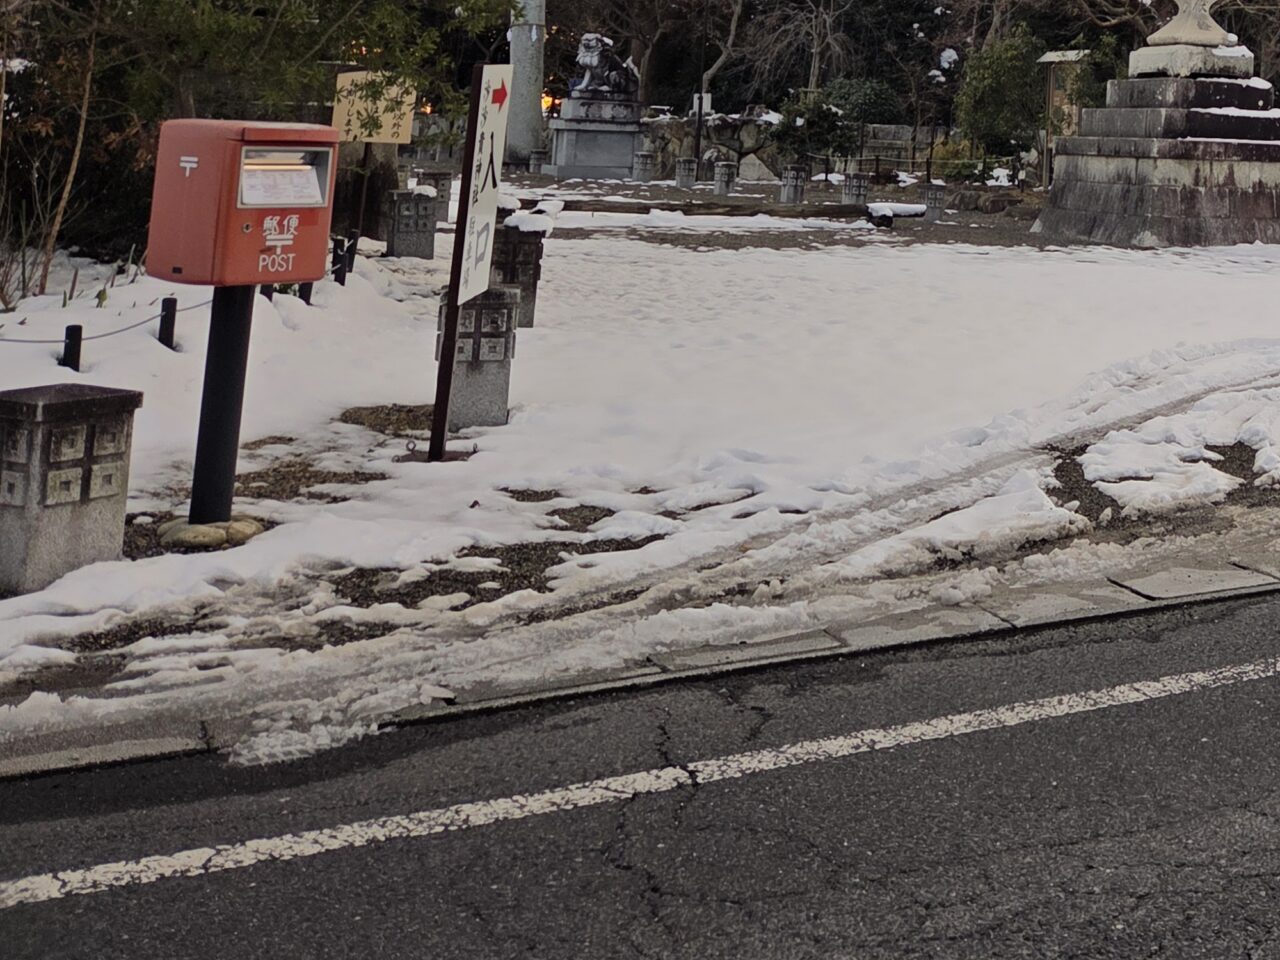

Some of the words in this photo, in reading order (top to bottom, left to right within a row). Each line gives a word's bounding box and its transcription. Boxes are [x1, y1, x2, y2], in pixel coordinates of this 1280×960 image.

[475, 131, 498, 271] 入口
[262, 214, 300, 236] 郵便
[258, 253, 297, 273] POST
